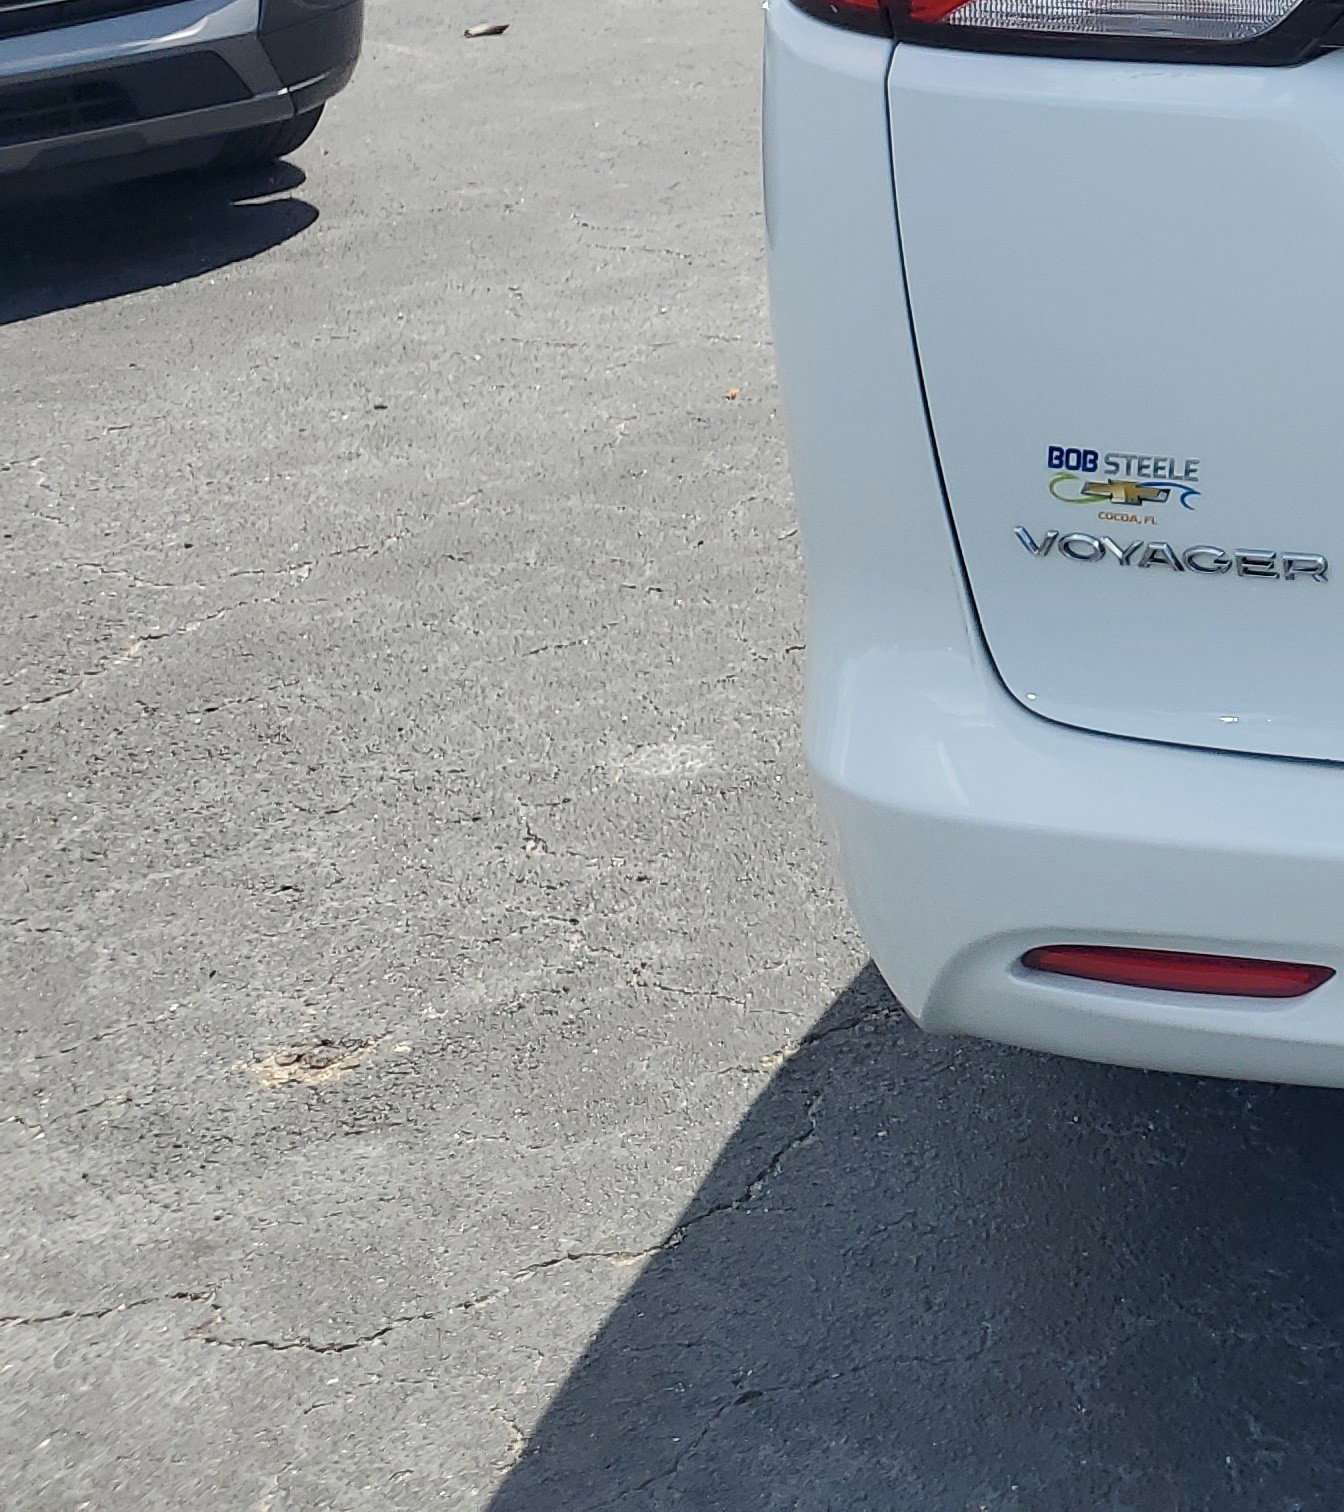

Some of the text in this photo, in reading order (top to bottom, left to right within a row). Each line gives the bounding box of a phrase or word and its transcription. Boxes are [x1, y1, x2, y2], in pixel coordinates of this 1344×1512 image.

[1047, 445, 1200, 482] BOB STEELE
[1098, 511, 1157, 525] COCOA, FL
[1013, 526, 1329, 582] VOYAGER
